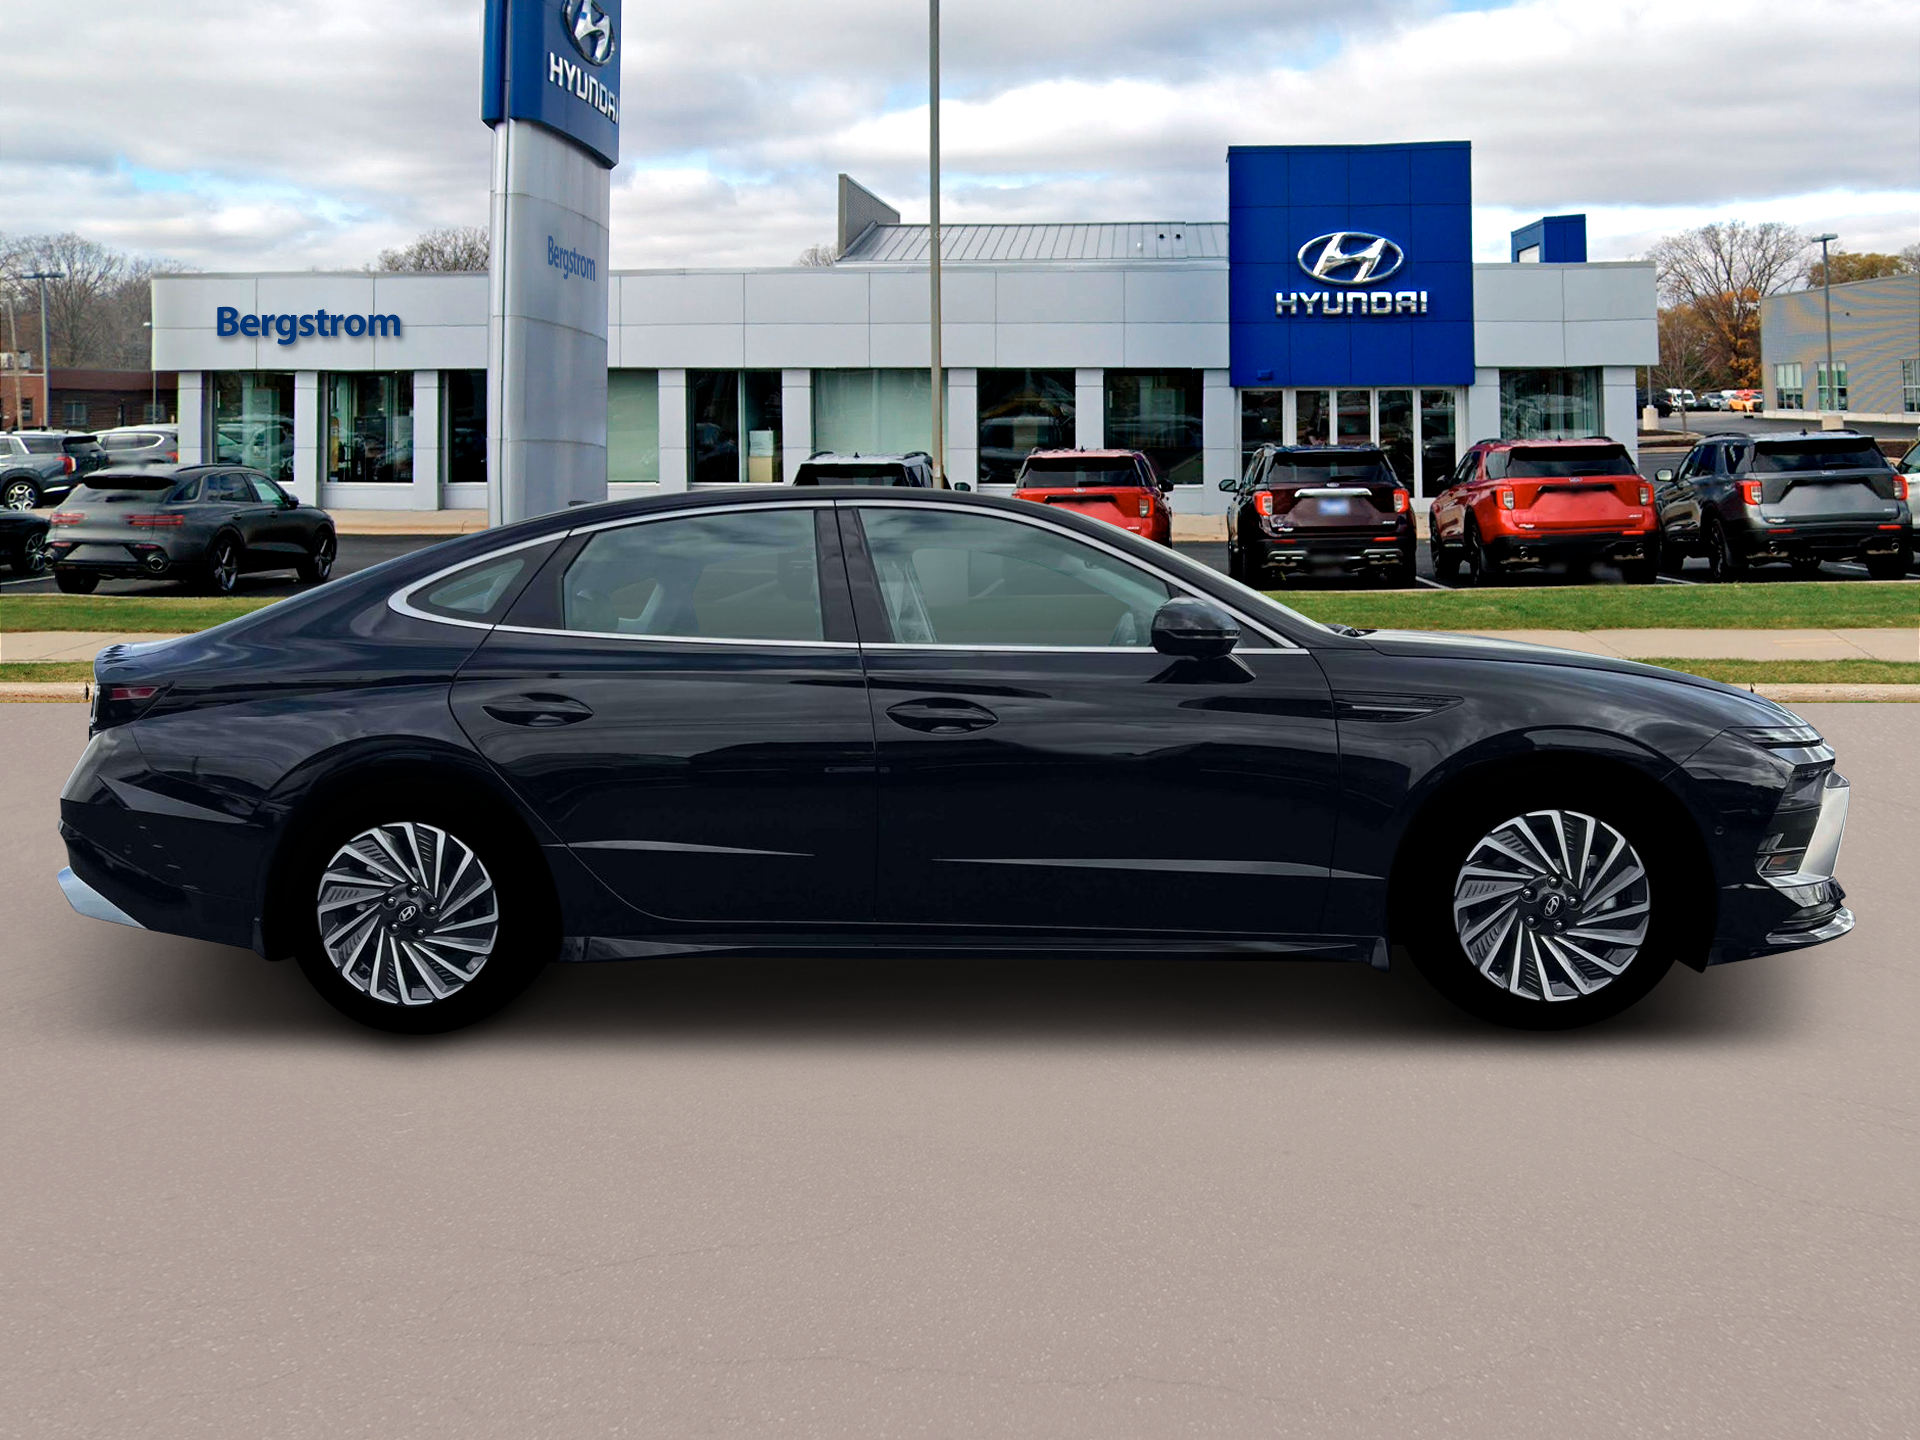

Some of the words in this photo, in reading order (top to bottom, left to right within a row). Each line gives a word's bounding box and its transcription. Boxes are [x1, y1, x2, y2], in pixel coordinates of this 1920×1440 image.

[549, 51, 619, 124] HYUNDAI
[547, 235, 596, 282] Bergstrom
[1275, 291, 1428, 316] HYUNDAI
[216, 306, 402, 346] Bergstrom
